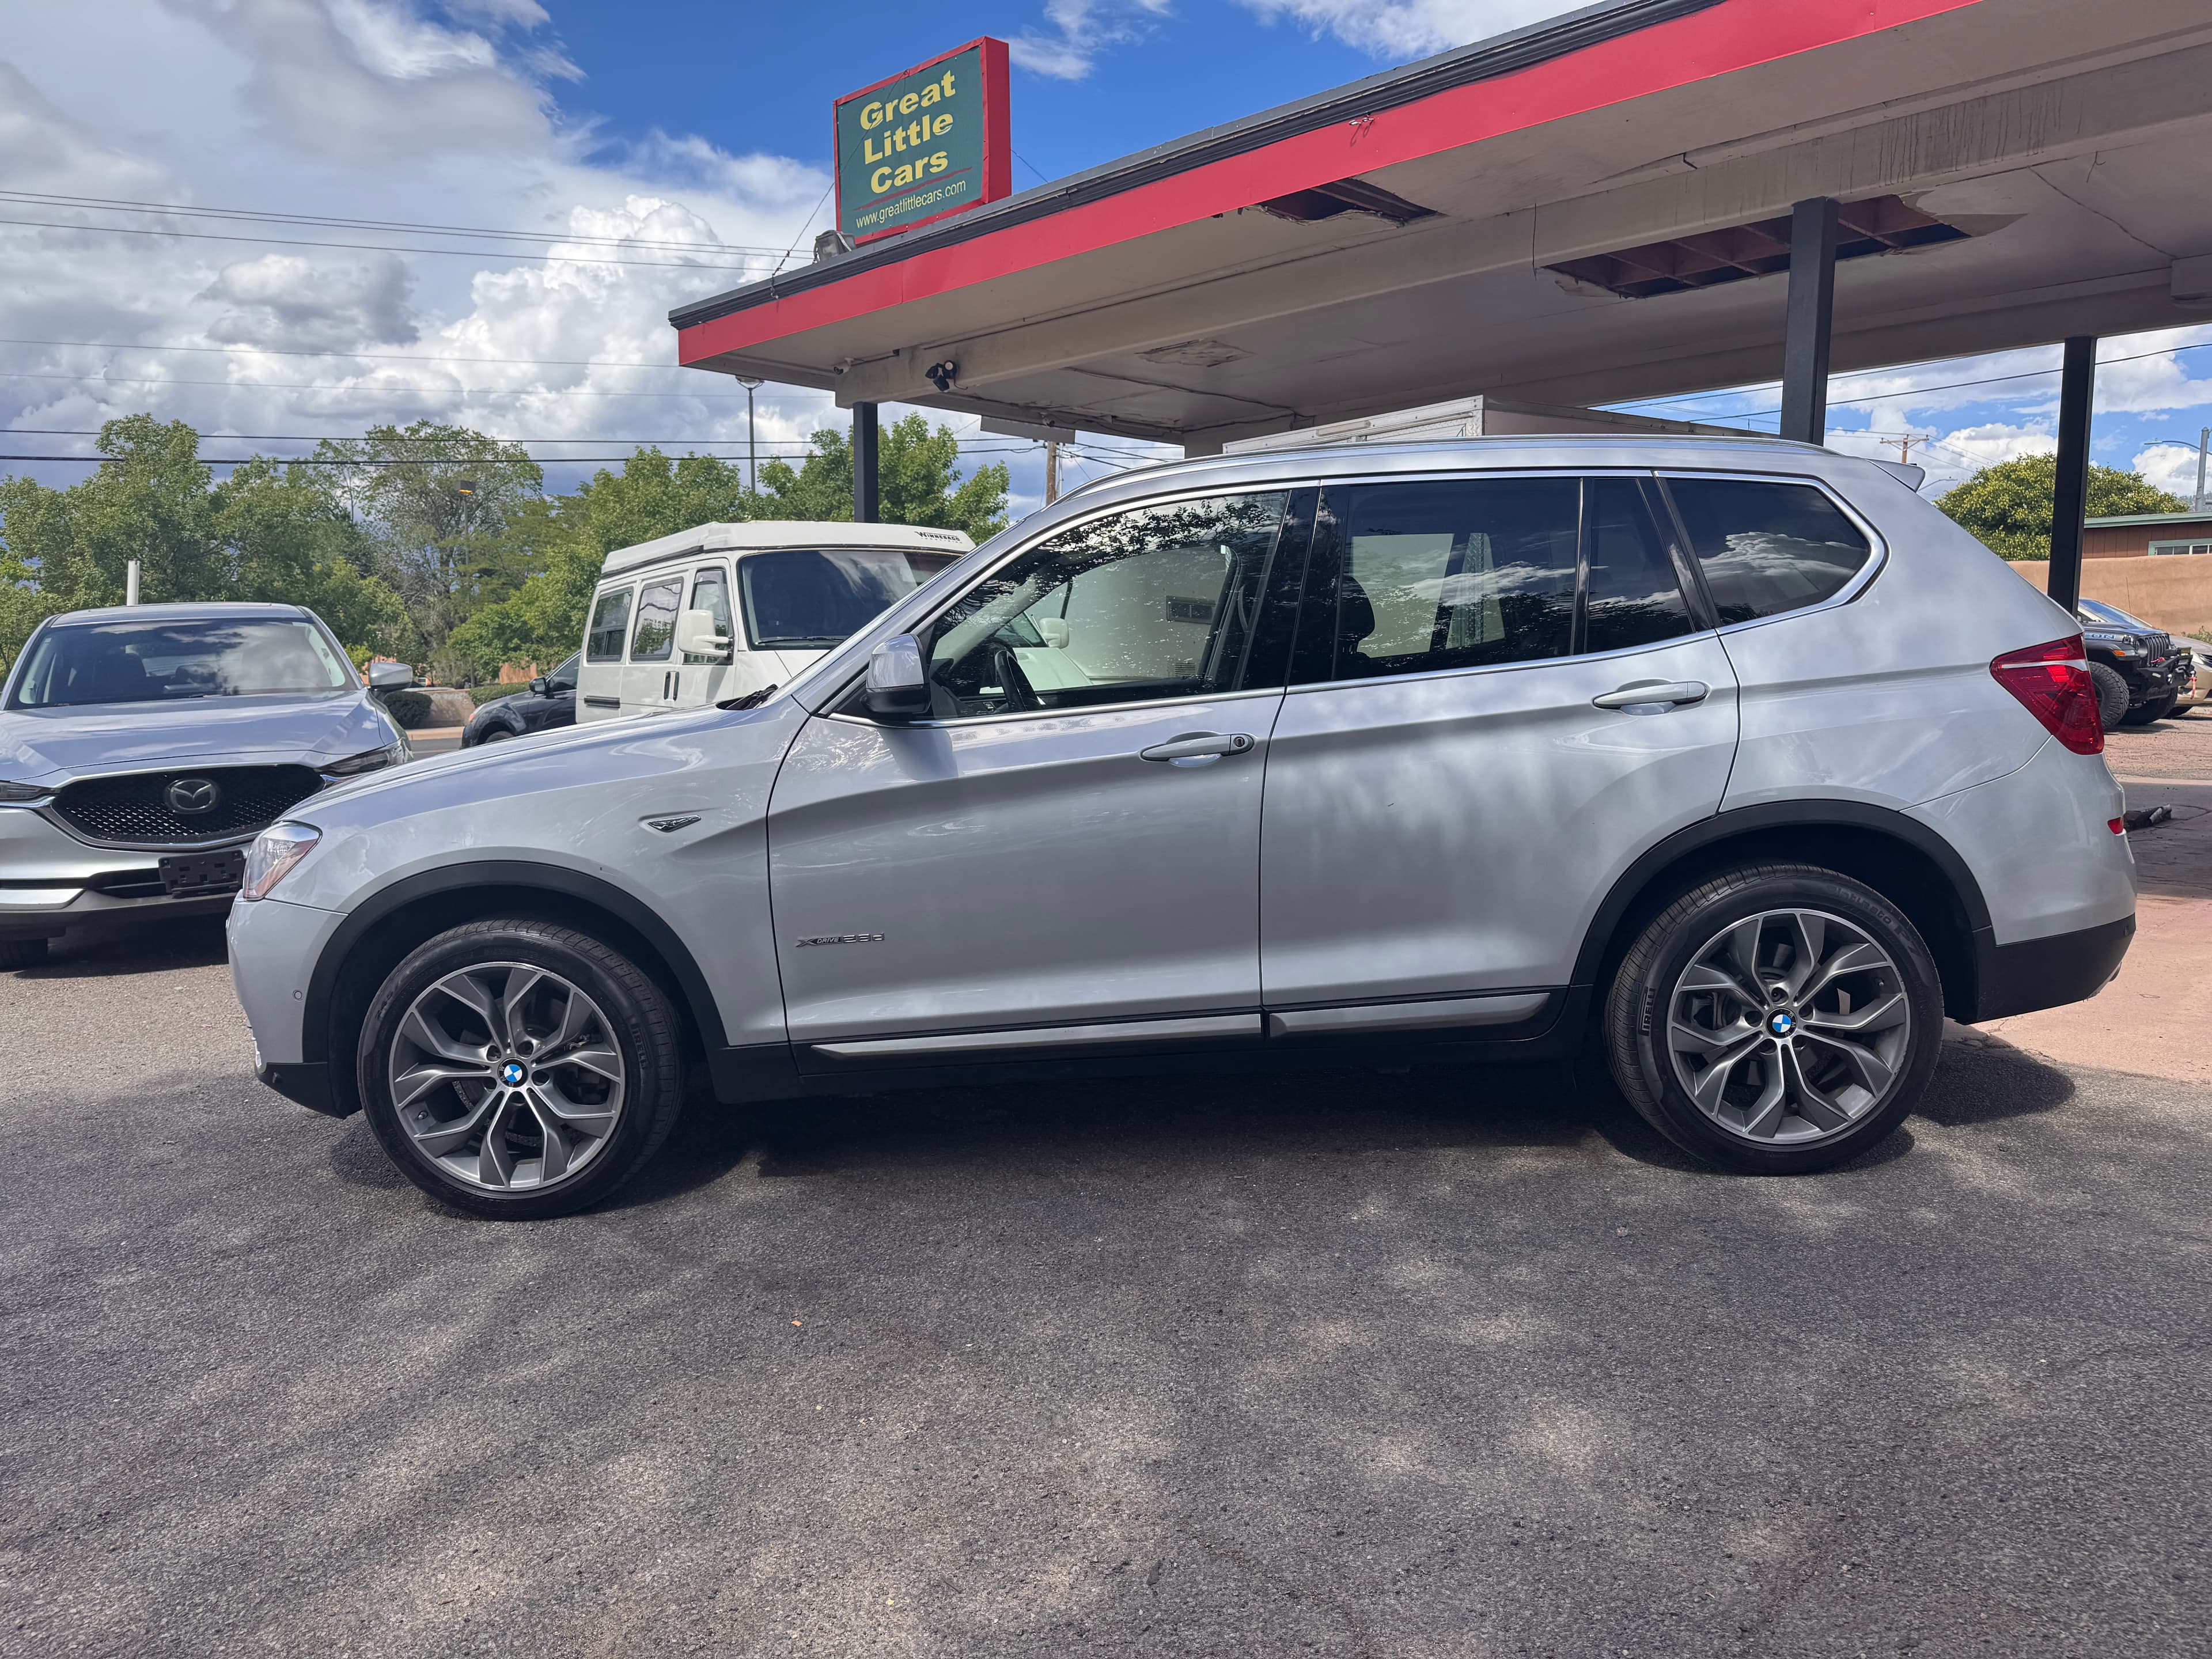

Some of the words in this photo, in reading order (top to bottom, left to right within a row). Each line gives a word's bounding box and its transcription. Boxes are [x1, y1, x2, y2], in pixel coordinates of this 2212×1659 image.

[860, 70, 956, 130] Great
[864, 113, 953, 165] Little
[870, 151, 948, 194] Cars
[856, 180, 966, 228] www.greatlittlecars.com
[1638, 986, 1656, 1036] PIRELLI
